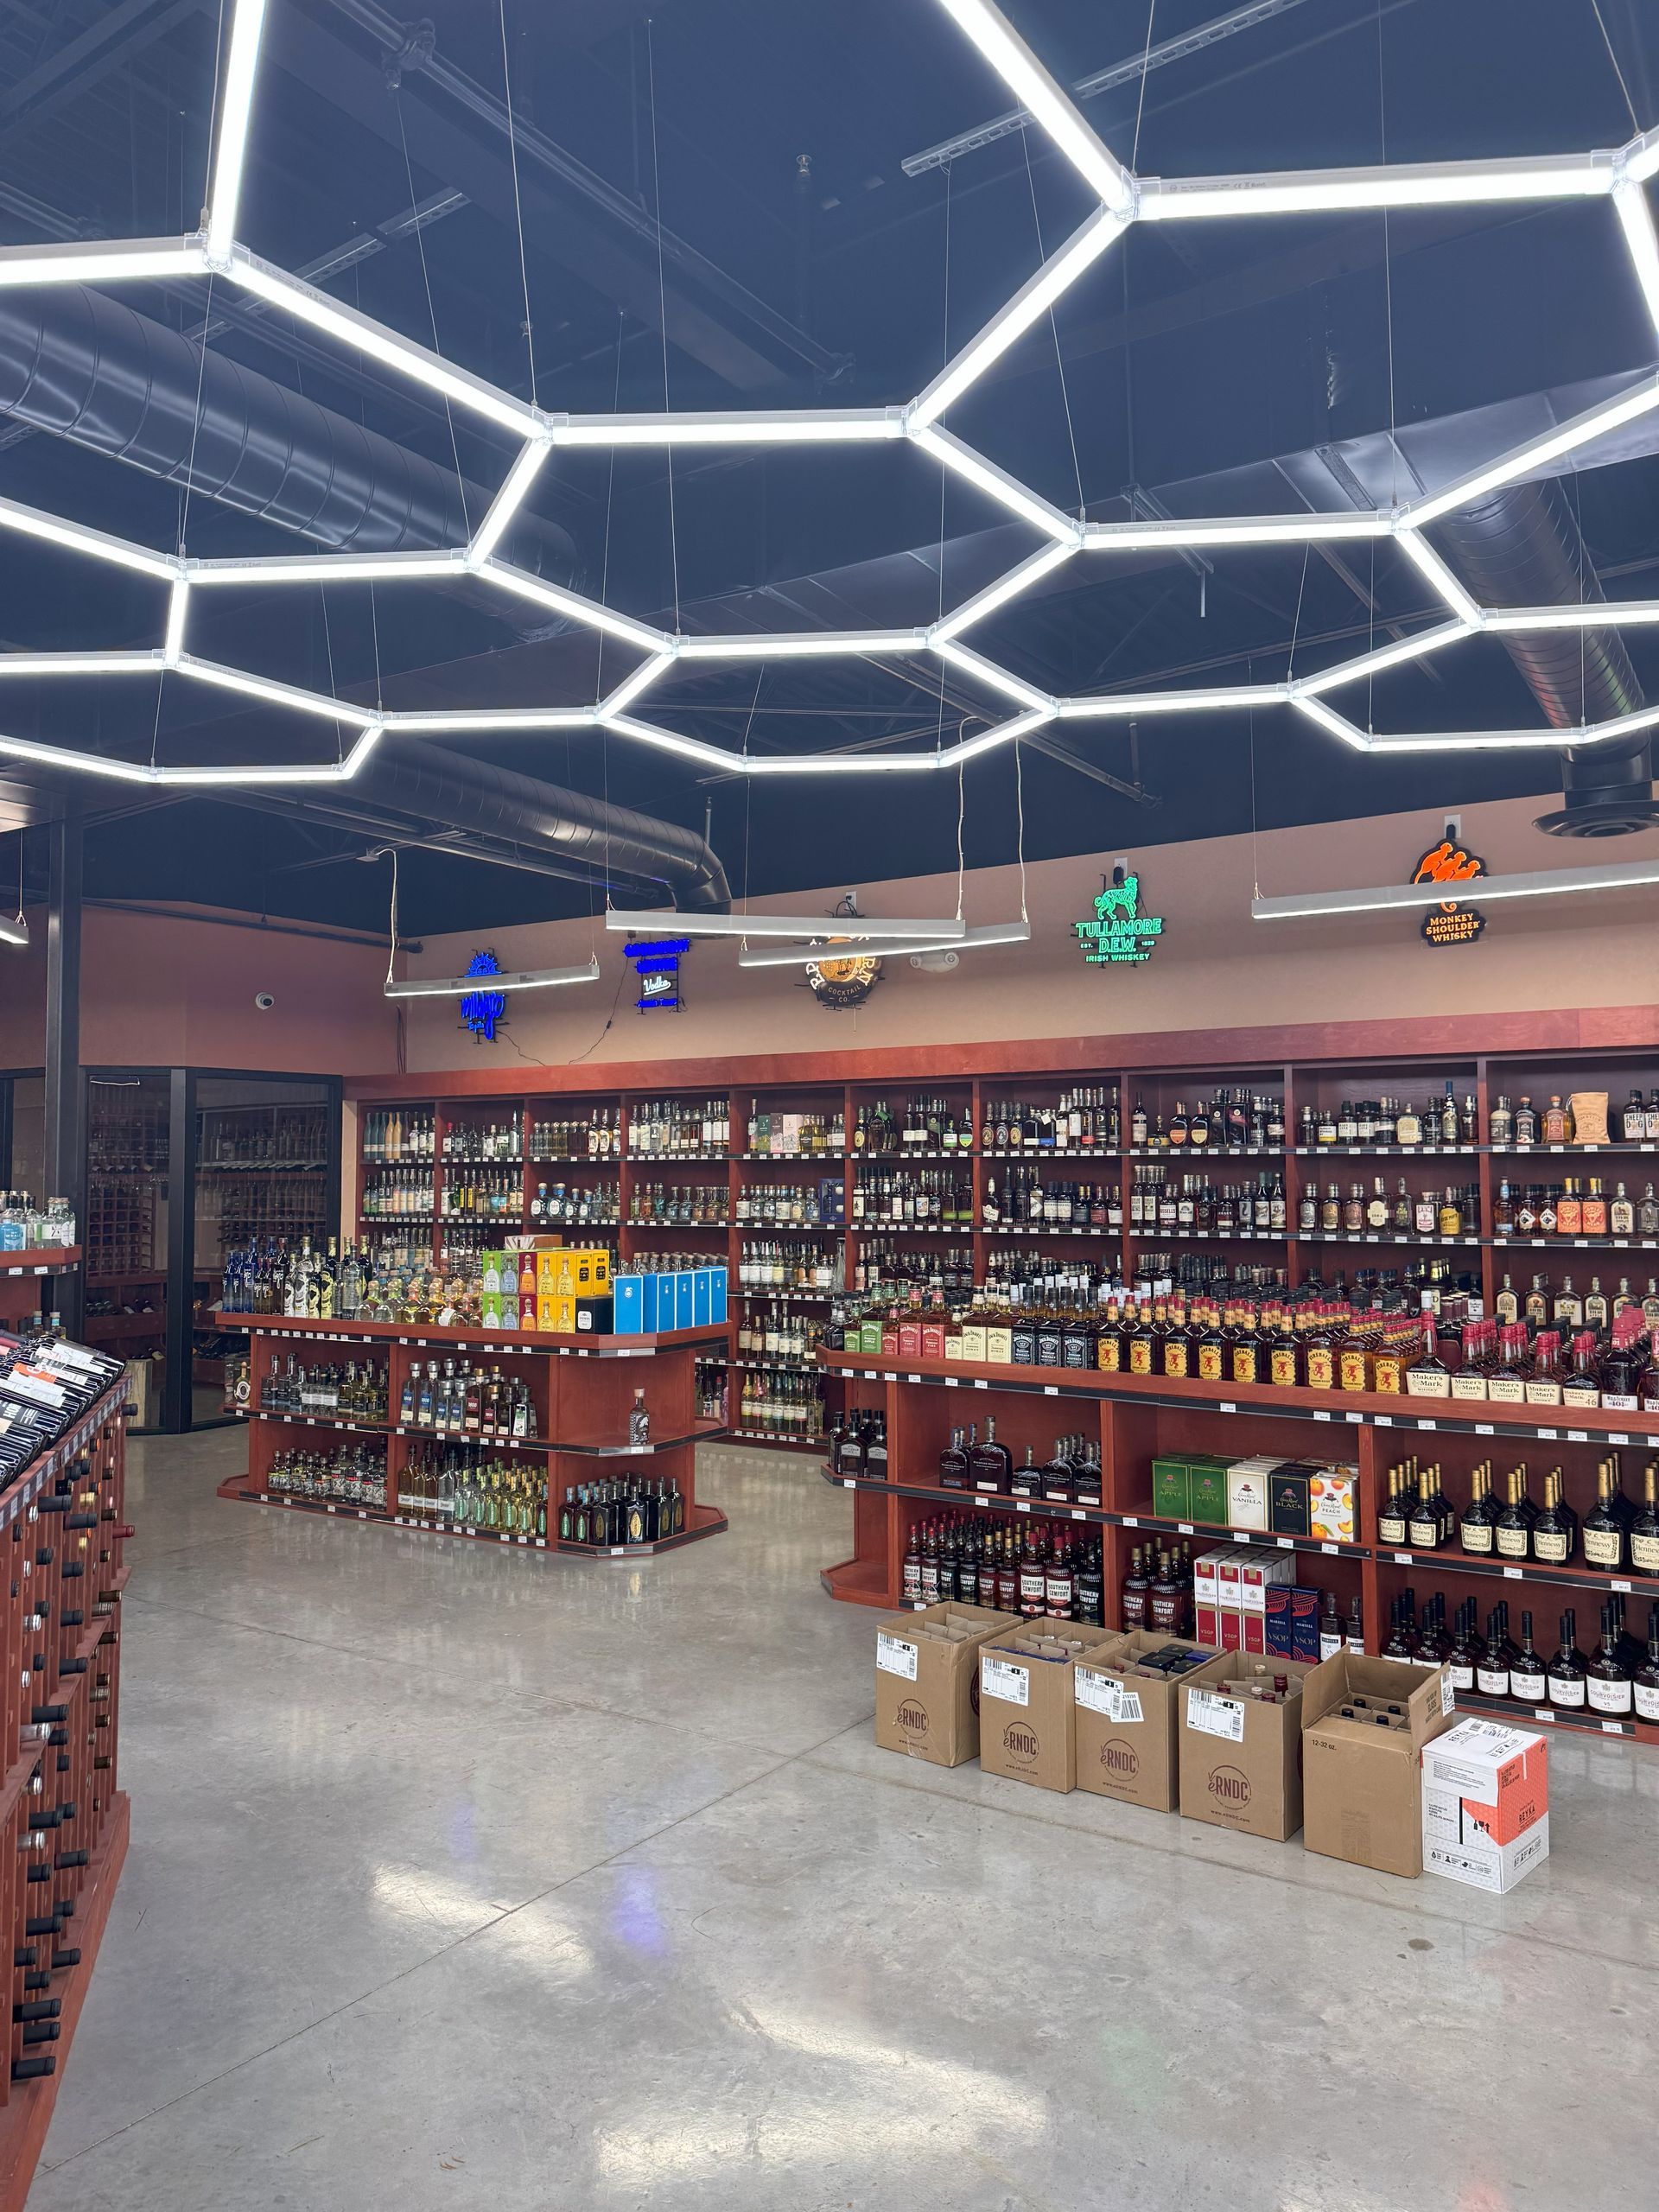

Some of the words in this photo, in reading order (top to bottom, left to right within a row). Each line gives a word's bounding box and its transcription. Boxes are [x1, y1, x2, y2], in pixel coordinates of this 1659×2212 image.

[1430, 913, 1473, 926] MONKEY
[1076, 918, 1162, 938] TULLAMORE
[1426, 921, 1479, 935] SHOULDER
[1433, 931, 1473, 942] WHISKY
[1098, 937, 1137, 953] D.E.W.
[644, 976, 671, 995] Vodka
[828, 985, 861, 996] COCKTAIL
[1585, 1397, 1597, 1406] 46
[1232, 1497, 1262, 1505] VANILLA
[1586, 1538, 1611, 1548] Hennessy
[1153, 1599, 1174, 1608] SOUTHERN
[1268, 1633, 1289, 1643] VSOP
[1294, 1636, 1316, 1645] VSOP
[1590, 1689, 1625, 1699] COURVOISIER
[897, 1708, 927, 1732] eRNDC
[1003, 1731, 1037, 1756] eRNDC
[1312, 1739, 1328, 1749] 12-32
[1100, 1748, 1136, 1774] eRNDC
[1208, 1775, 1249, 1802] eRNDC
[1519, 1805, 1535, 1823] REYKA
